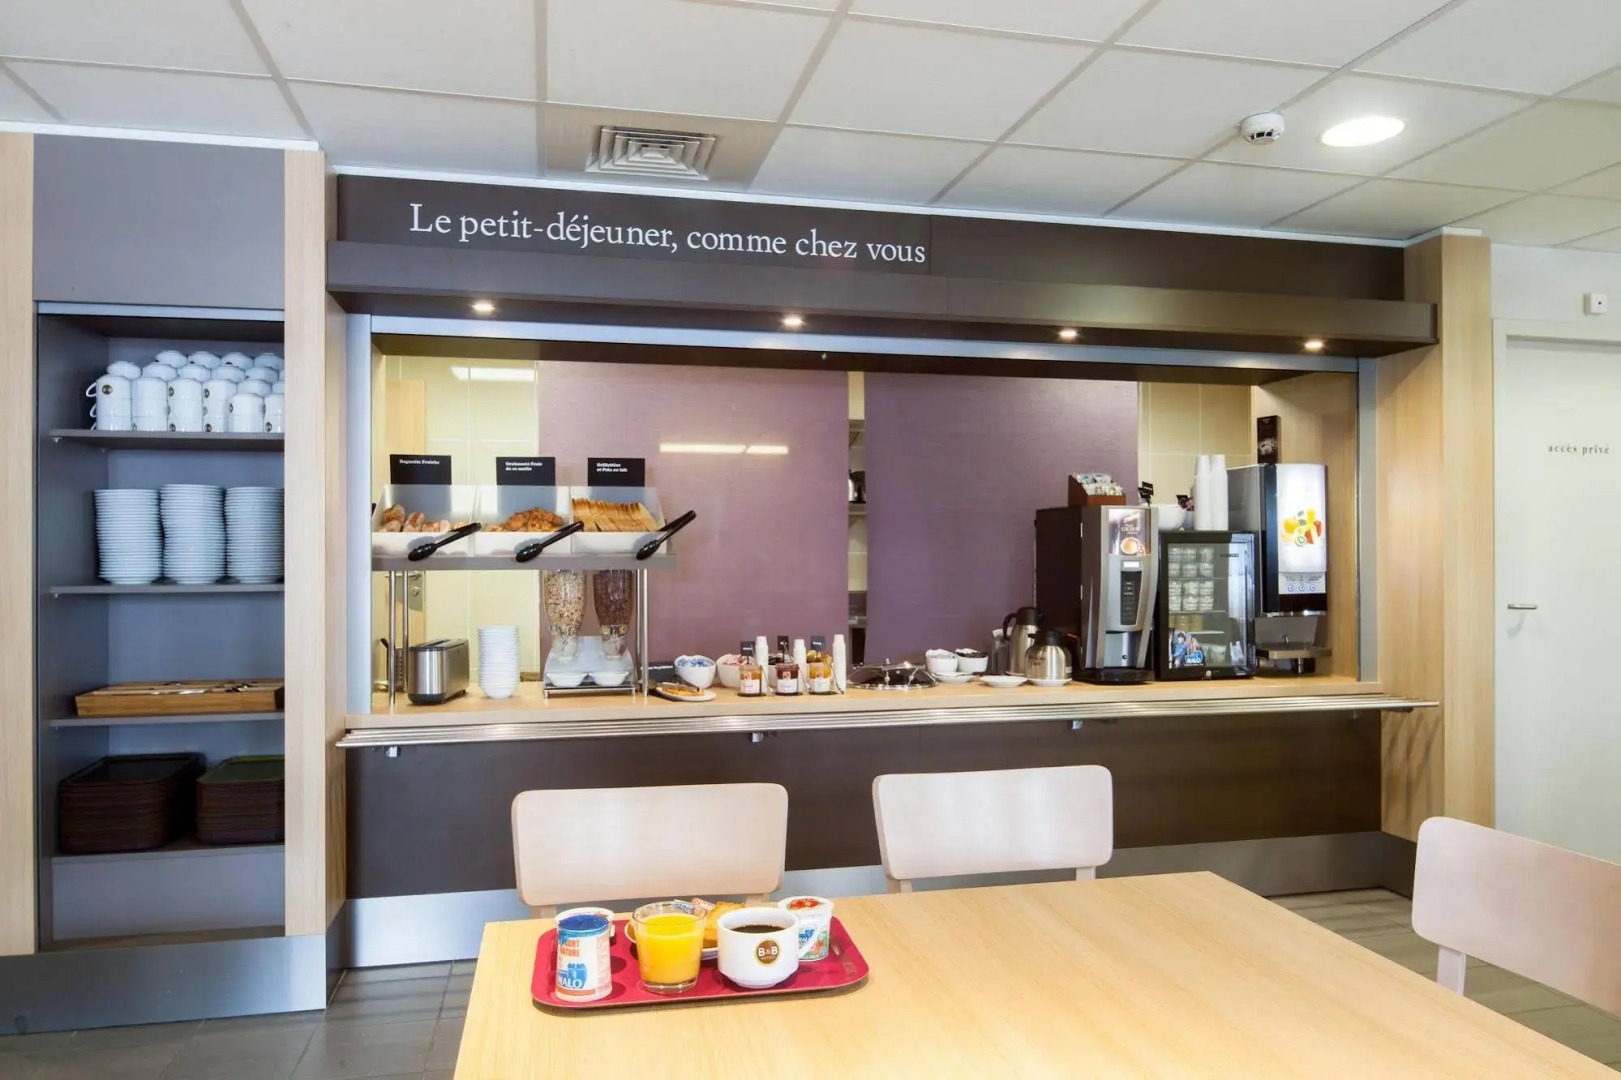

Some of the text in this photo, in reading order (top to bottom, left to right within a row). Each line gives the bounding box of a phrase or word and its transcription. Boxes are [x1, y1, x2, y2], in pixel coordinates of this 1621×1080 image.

[409, 203, 926, 263] Le petit-déjeuner, comme chez vous
